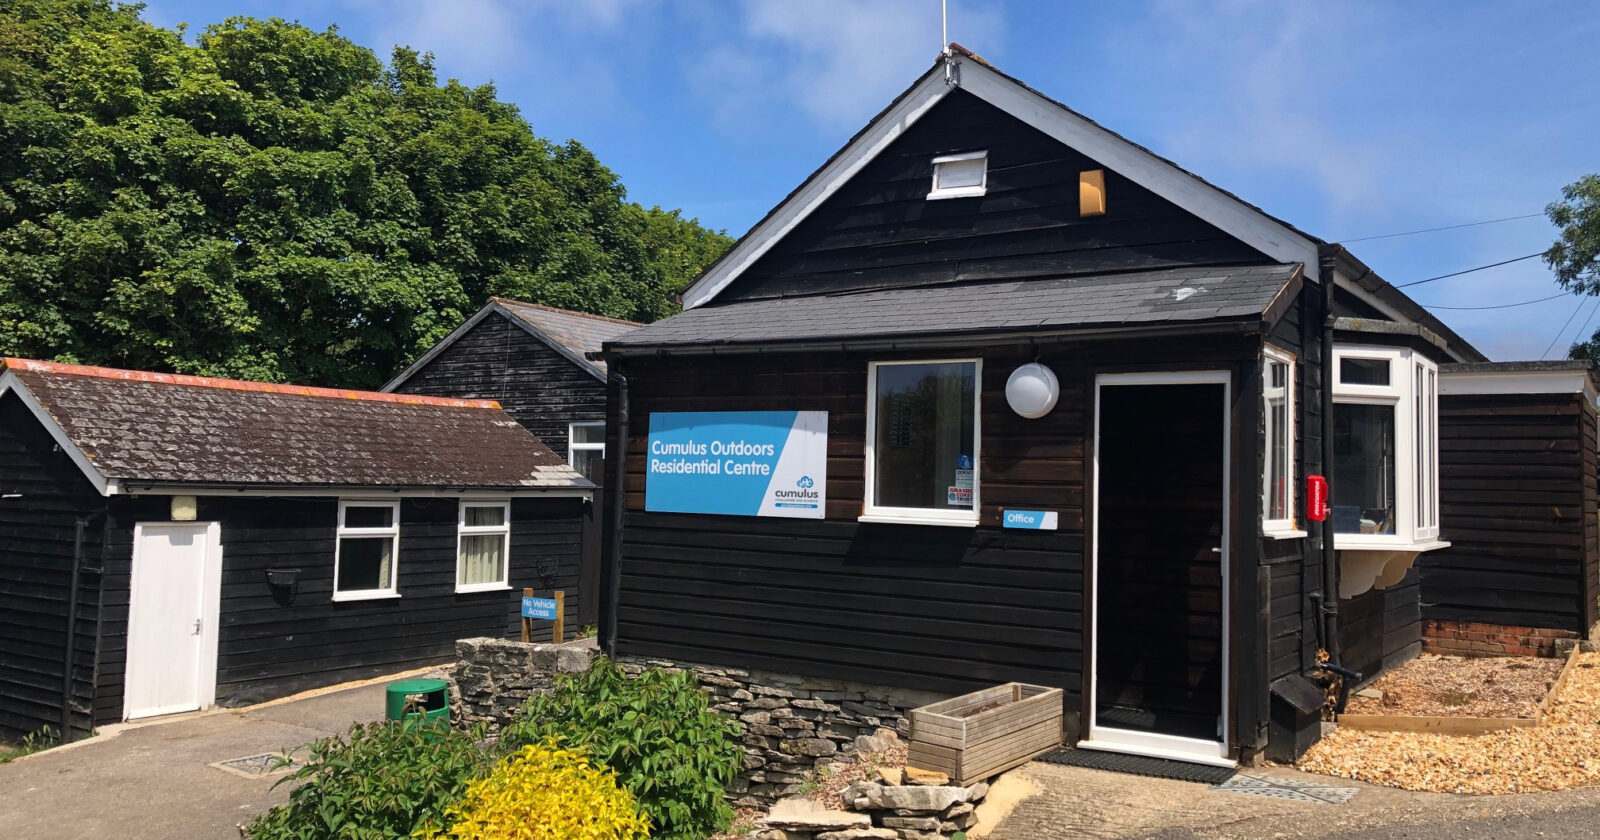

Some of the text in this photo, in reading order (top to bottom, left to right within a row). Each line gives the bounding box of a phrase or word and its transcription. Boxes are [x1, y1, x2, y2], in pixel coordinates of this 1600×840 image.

[651, 440, 775, 456] Cumulus Outdoors
[651, 458, 770, 475] Residential Centre
[775, 489, 819, 499] cumulus
[1007, 513, 1035, 524] Office
[523, 598, 556, 609] No Vehicle
[528, 607, 550, 617] Access
